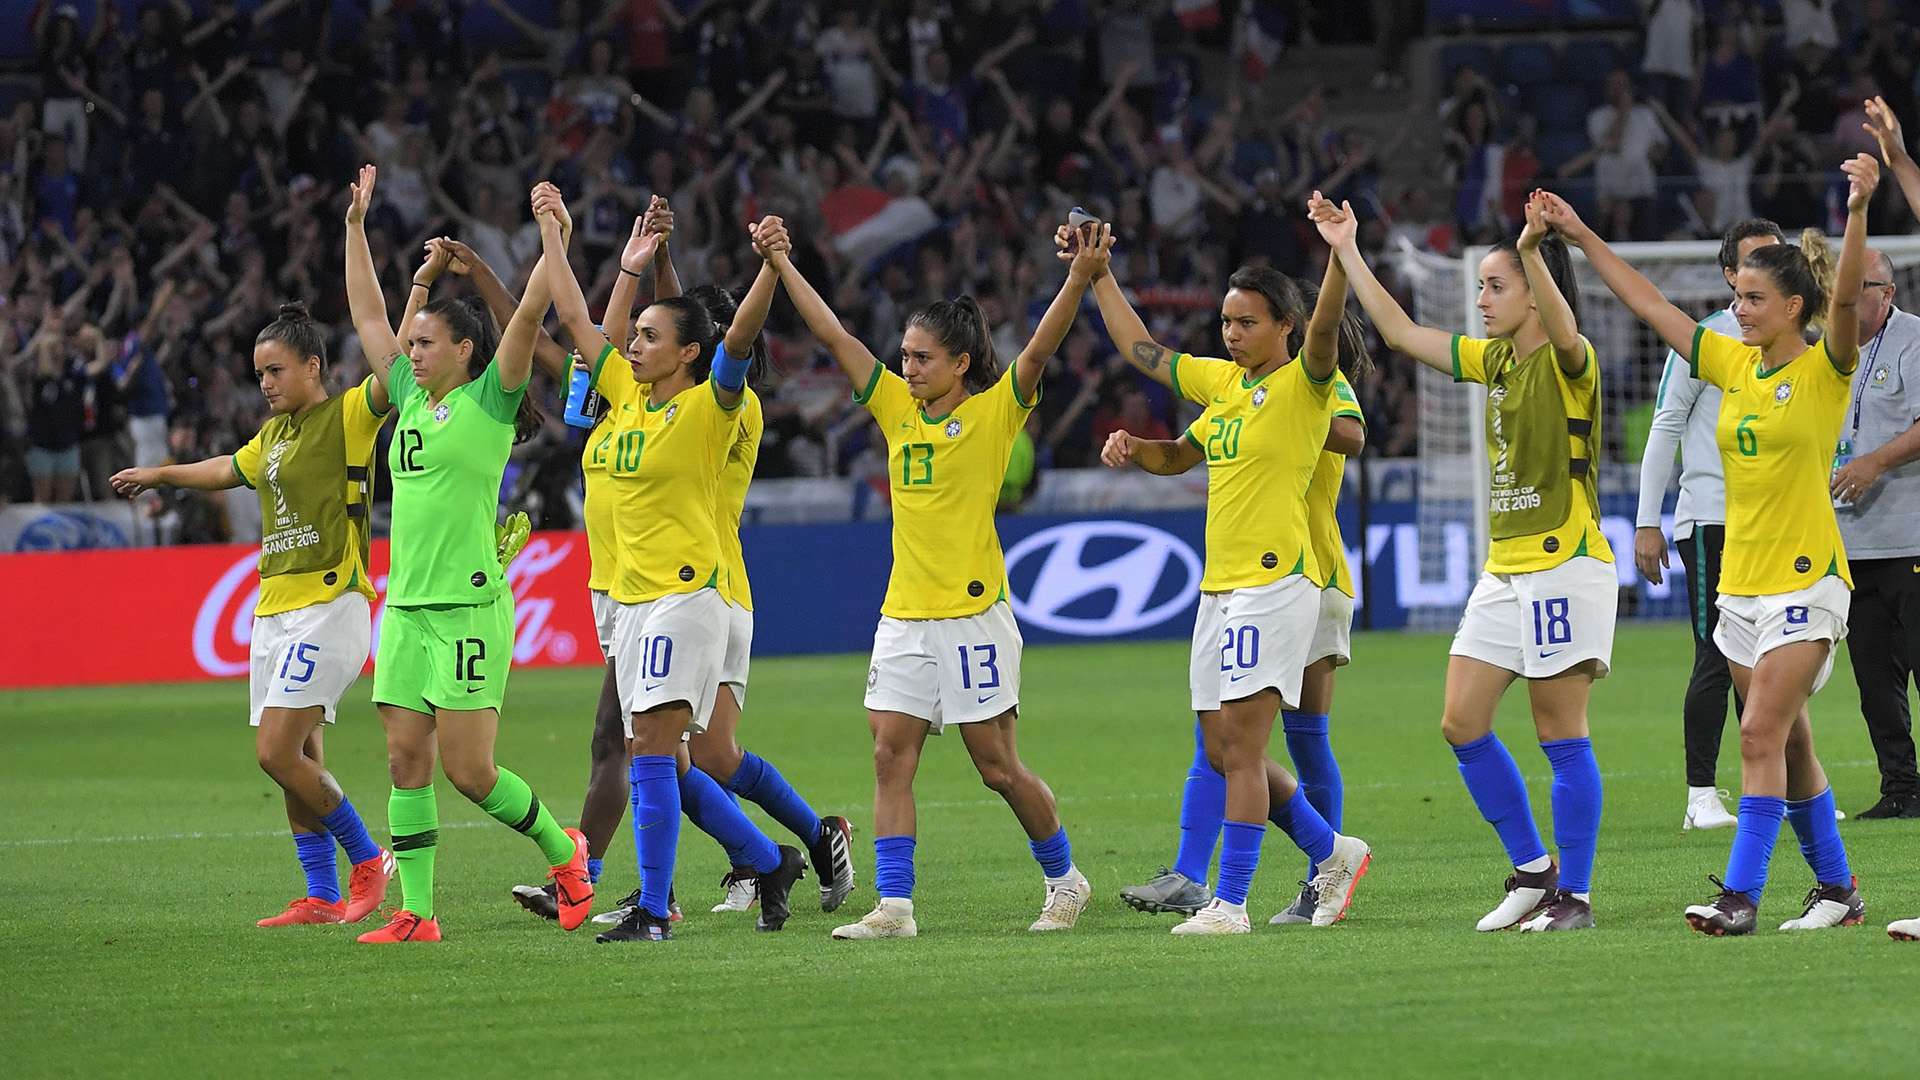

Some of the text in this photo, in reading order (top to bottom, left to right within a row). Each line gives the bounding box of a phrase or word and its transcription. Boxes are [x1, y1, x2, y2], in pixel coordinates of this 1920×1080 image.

[399, 428, 425, 472] 12
[615, 430, 645, 472] 10
[1207, 417, 1243, 462] 20
[1735, 414, 1759, 457] 6
[902, 442, 934, 486] 13
[1511, 493, 1541, 510] 2019
[297, 531, 319, 547] 2019
[303, 524, 313, 532] CUP
[1532, 597, 1572, 646] 18
[279, 642, 320, 683] 15
[455, 638, 486, 681] 12
[642, 635, 673, 679] 10
[958, 644, 1000, 689] 13
[1220, 625, 1260, 672] 20
